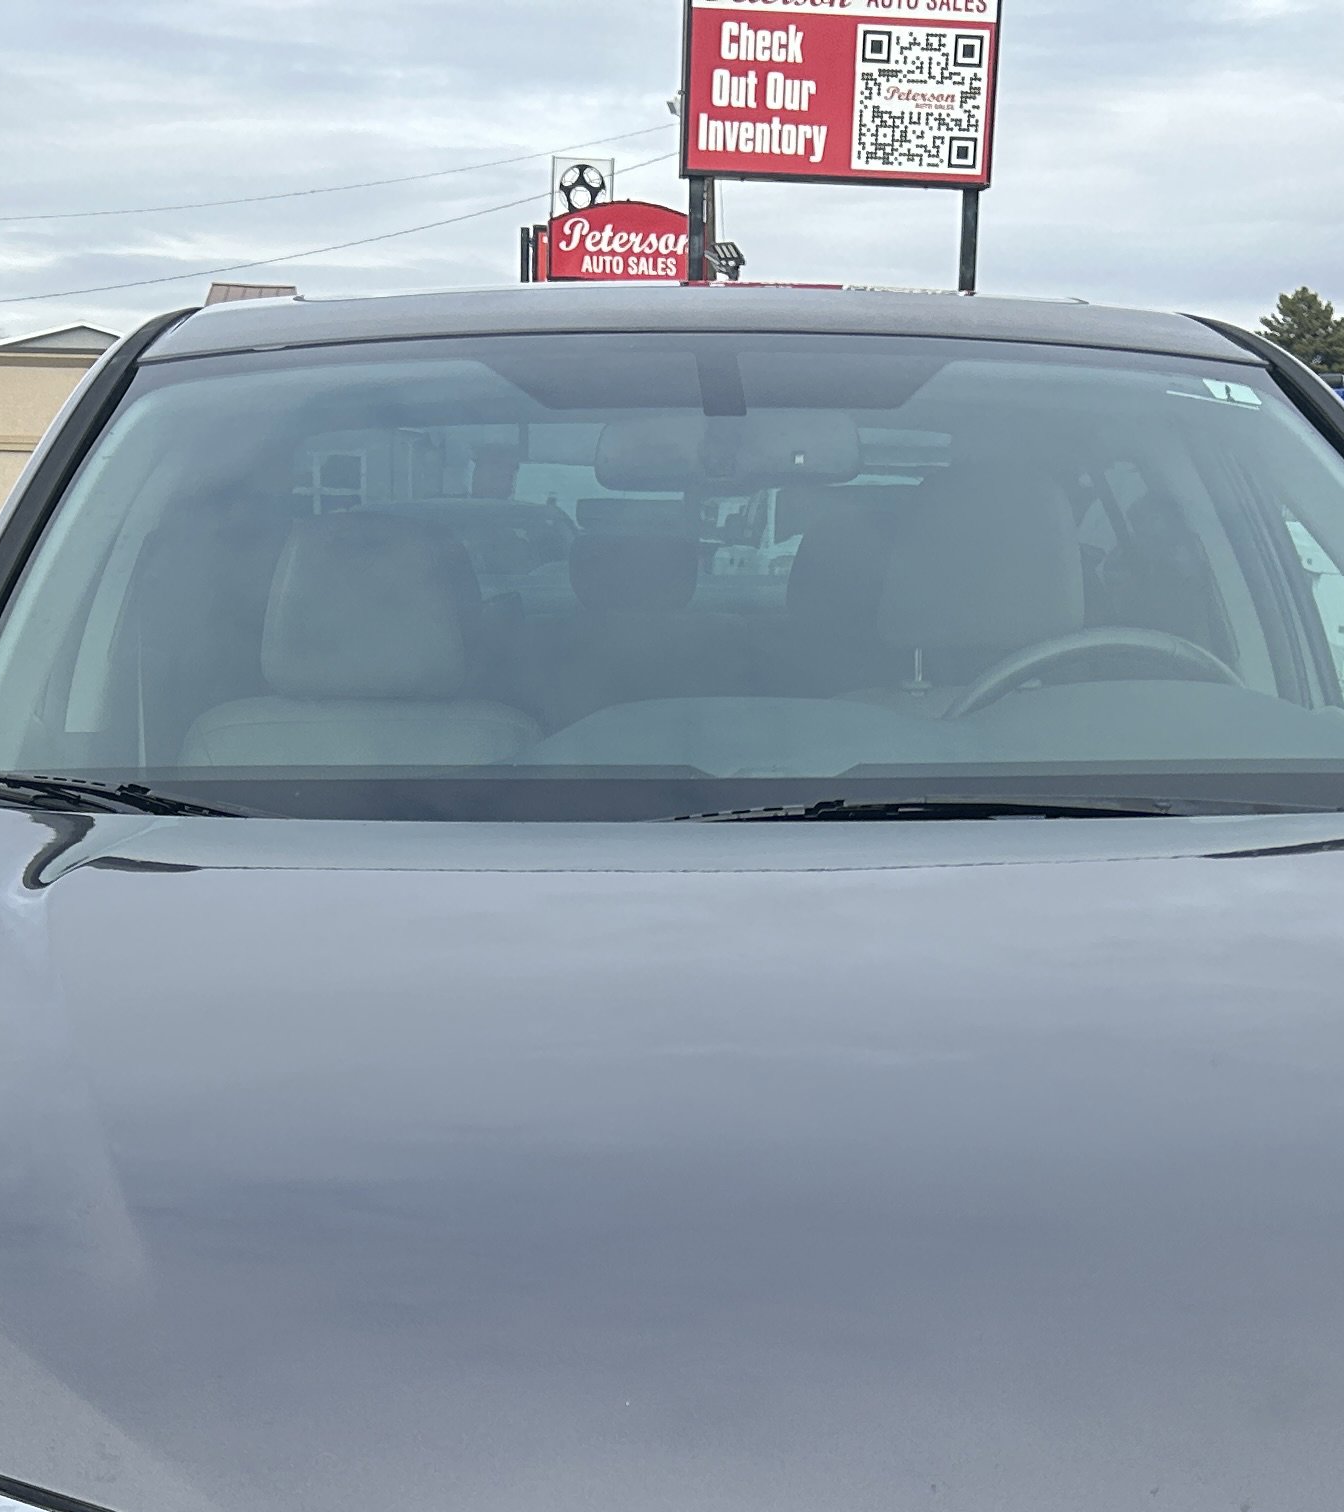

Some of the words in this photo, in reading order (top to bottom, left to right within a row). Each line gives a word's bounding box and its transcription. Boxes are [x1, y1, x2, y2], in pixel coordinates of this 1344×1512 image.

[720, 21, 804, 64] Check
[711, 68, 758, 110] Out
[765, 71, 816, 112] Our
[698, 113, 828, 163] Inventory
[581, 255, 624, 275] AUTO
[627, 256, 677, 277] SALES
